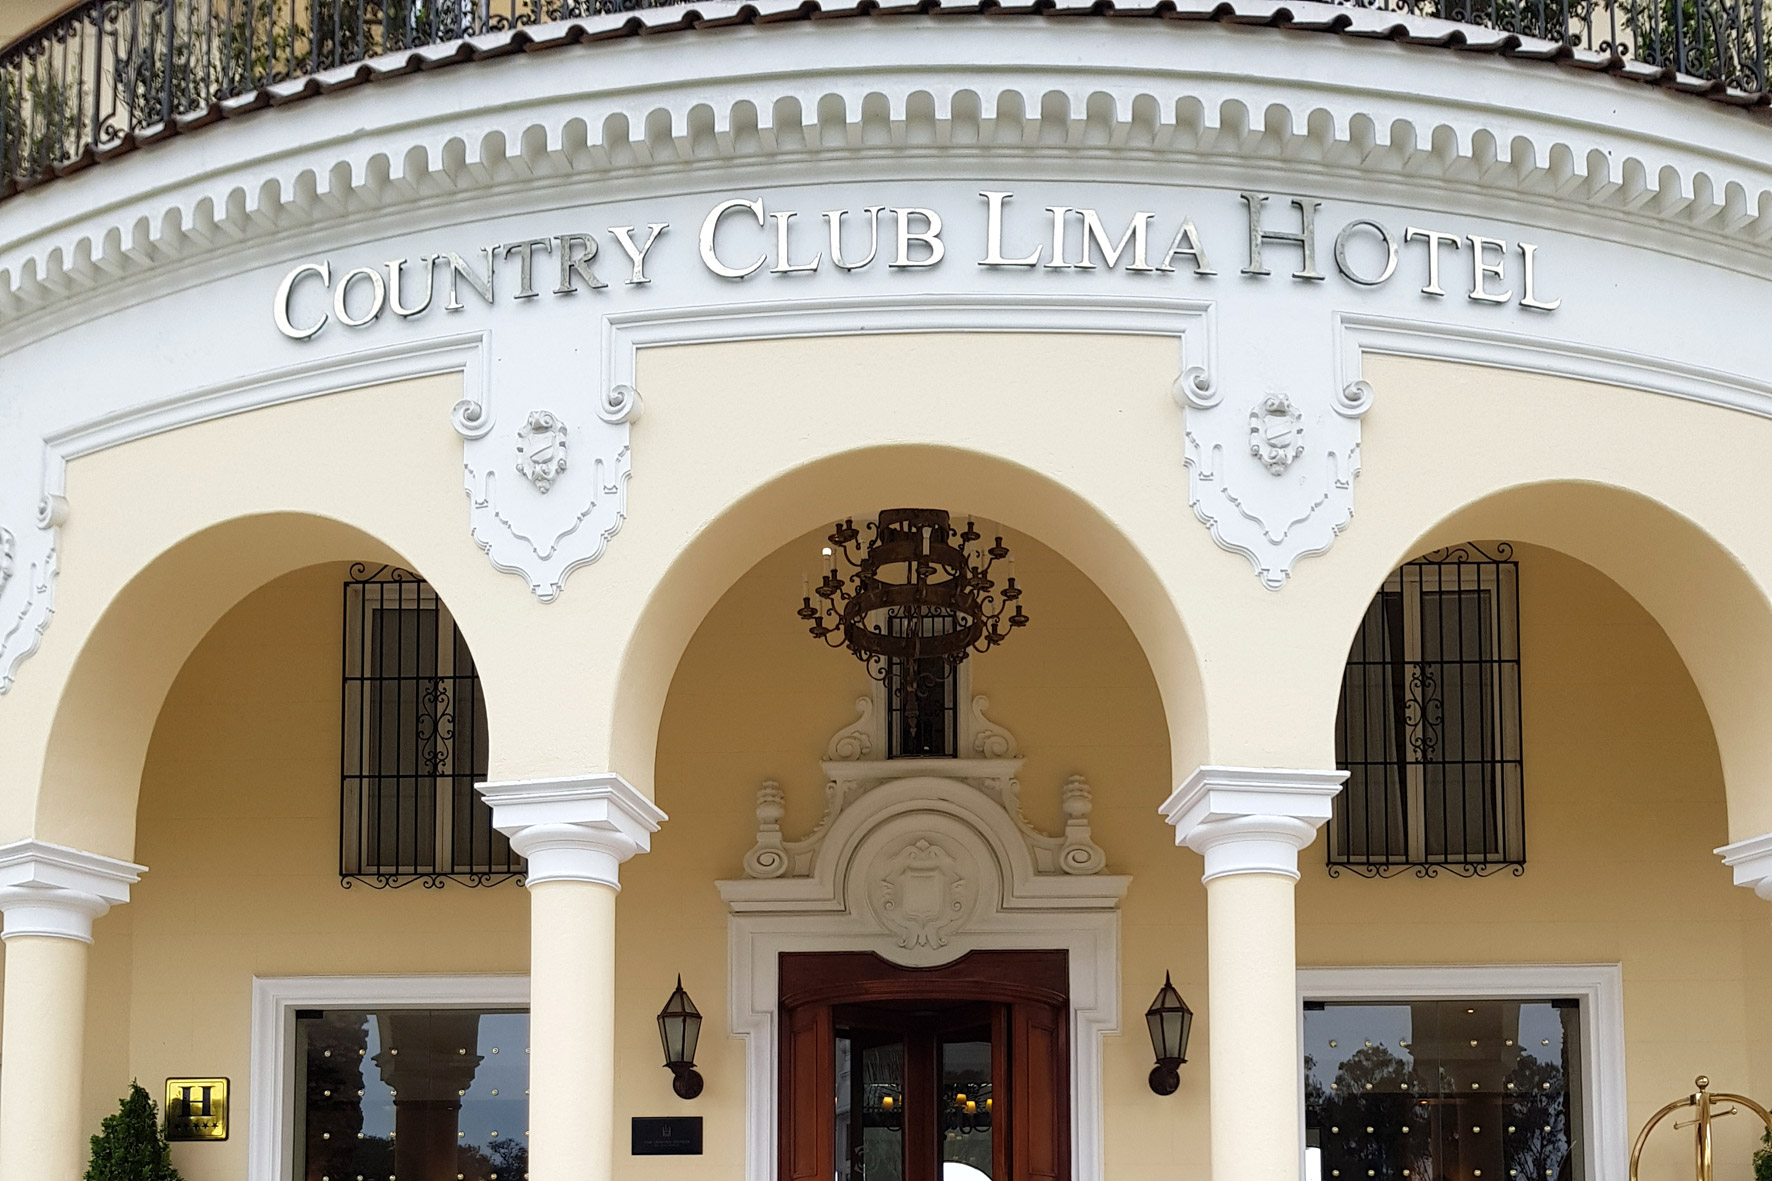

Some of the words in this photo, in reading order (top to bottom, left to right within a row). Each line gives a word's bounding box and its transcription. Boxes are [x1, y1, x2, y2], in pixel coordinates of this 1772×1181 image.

[273, 222, 669, 340] COUNTRY
[698, 196, 946, 279] CLUB
[977, 190, 1218, 276] LIMA
[1240, 192, 1562, 312] HOTEL
[177, 1085, 216, 1117] H
